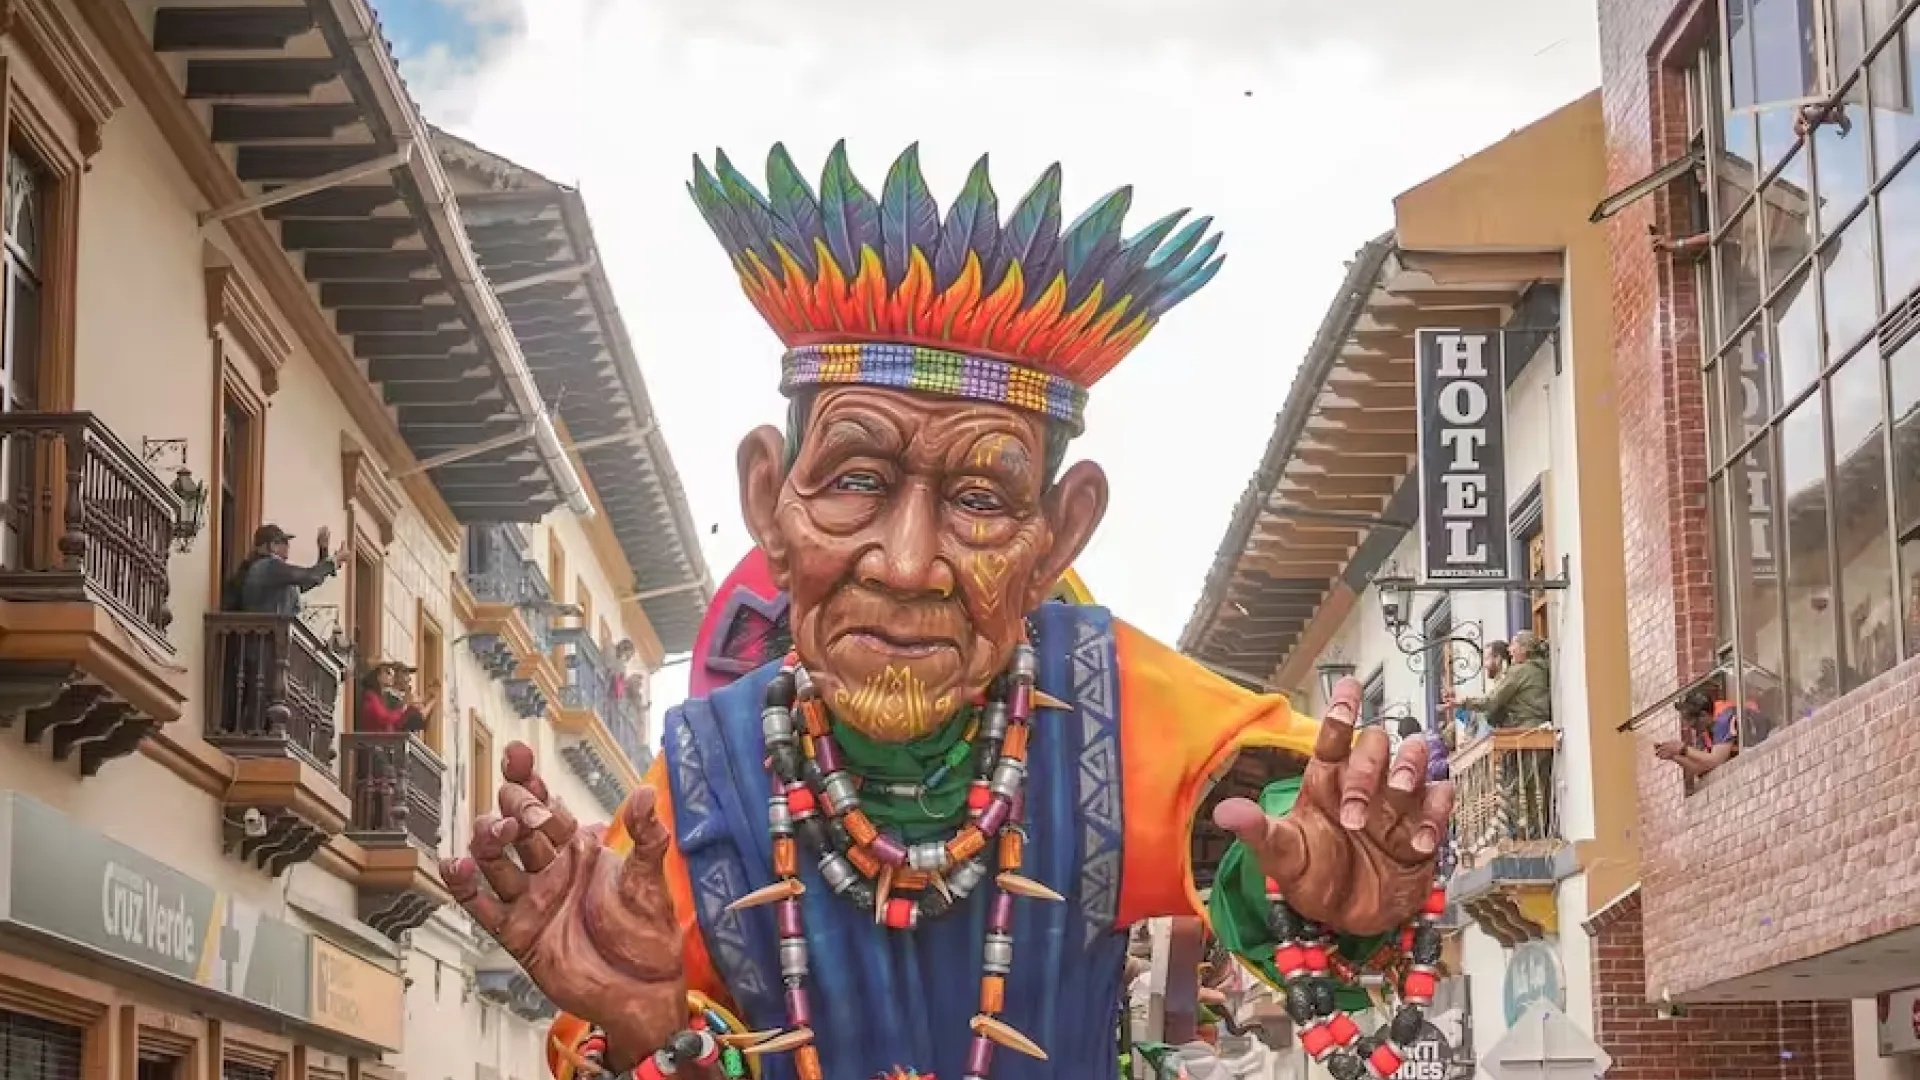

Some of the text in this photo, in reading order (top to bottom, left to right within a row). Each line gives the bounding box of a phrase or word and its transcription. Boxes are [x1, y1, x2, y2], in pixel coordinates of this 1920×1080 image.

[1436, 335, 1488, 564] HOTEL
[102, 861, 195, 963] Cruz Verde
